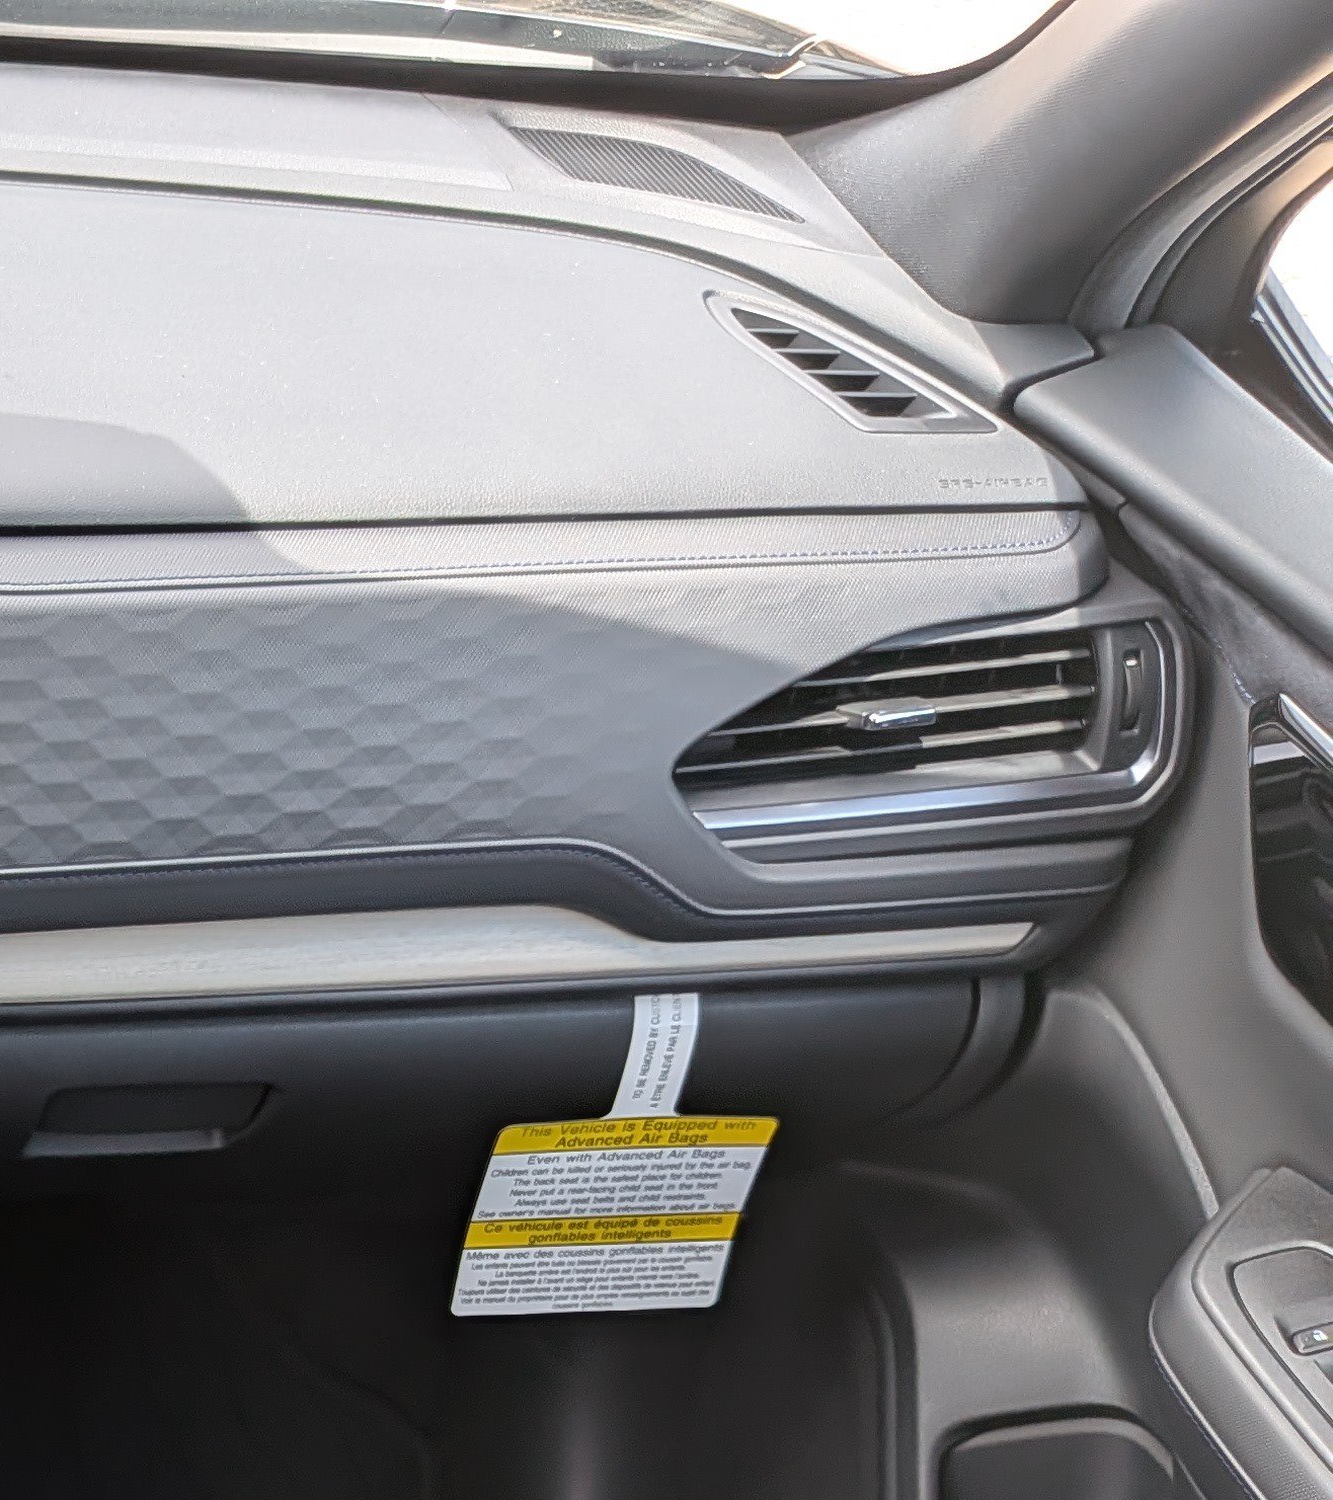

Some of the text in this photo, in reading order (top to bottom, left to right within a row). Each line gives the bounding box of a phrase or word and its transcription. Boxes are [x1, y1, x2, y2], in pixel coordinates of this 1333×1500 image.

[520, 1119, 756, 1137] This Vehicle is Equipped with
[555, 1133, 709, 1148] Advanced Air Bags
[527, 1149, 725, 1165] Even with Advanced Air Bags
[491, 1168, 528, 1178] Children
[531, 1168, 549, 1176] can
[552, 1166, 564, 1174] be
[700, 1161, 714, 1169] the
[484, 1223, 503, 1233] Ce
[568, 1219, 588, 1230] est
[643, 1216, 660, 1227] de
[665, 1215, 722, 1226] coussins
[528, 1228, 671, 1245] gonflables intelligents
[503, 1251, 530, 1260] avec
[533, 1249, 553, 1258] des
[558, 1248, 605, 1258] coussins
